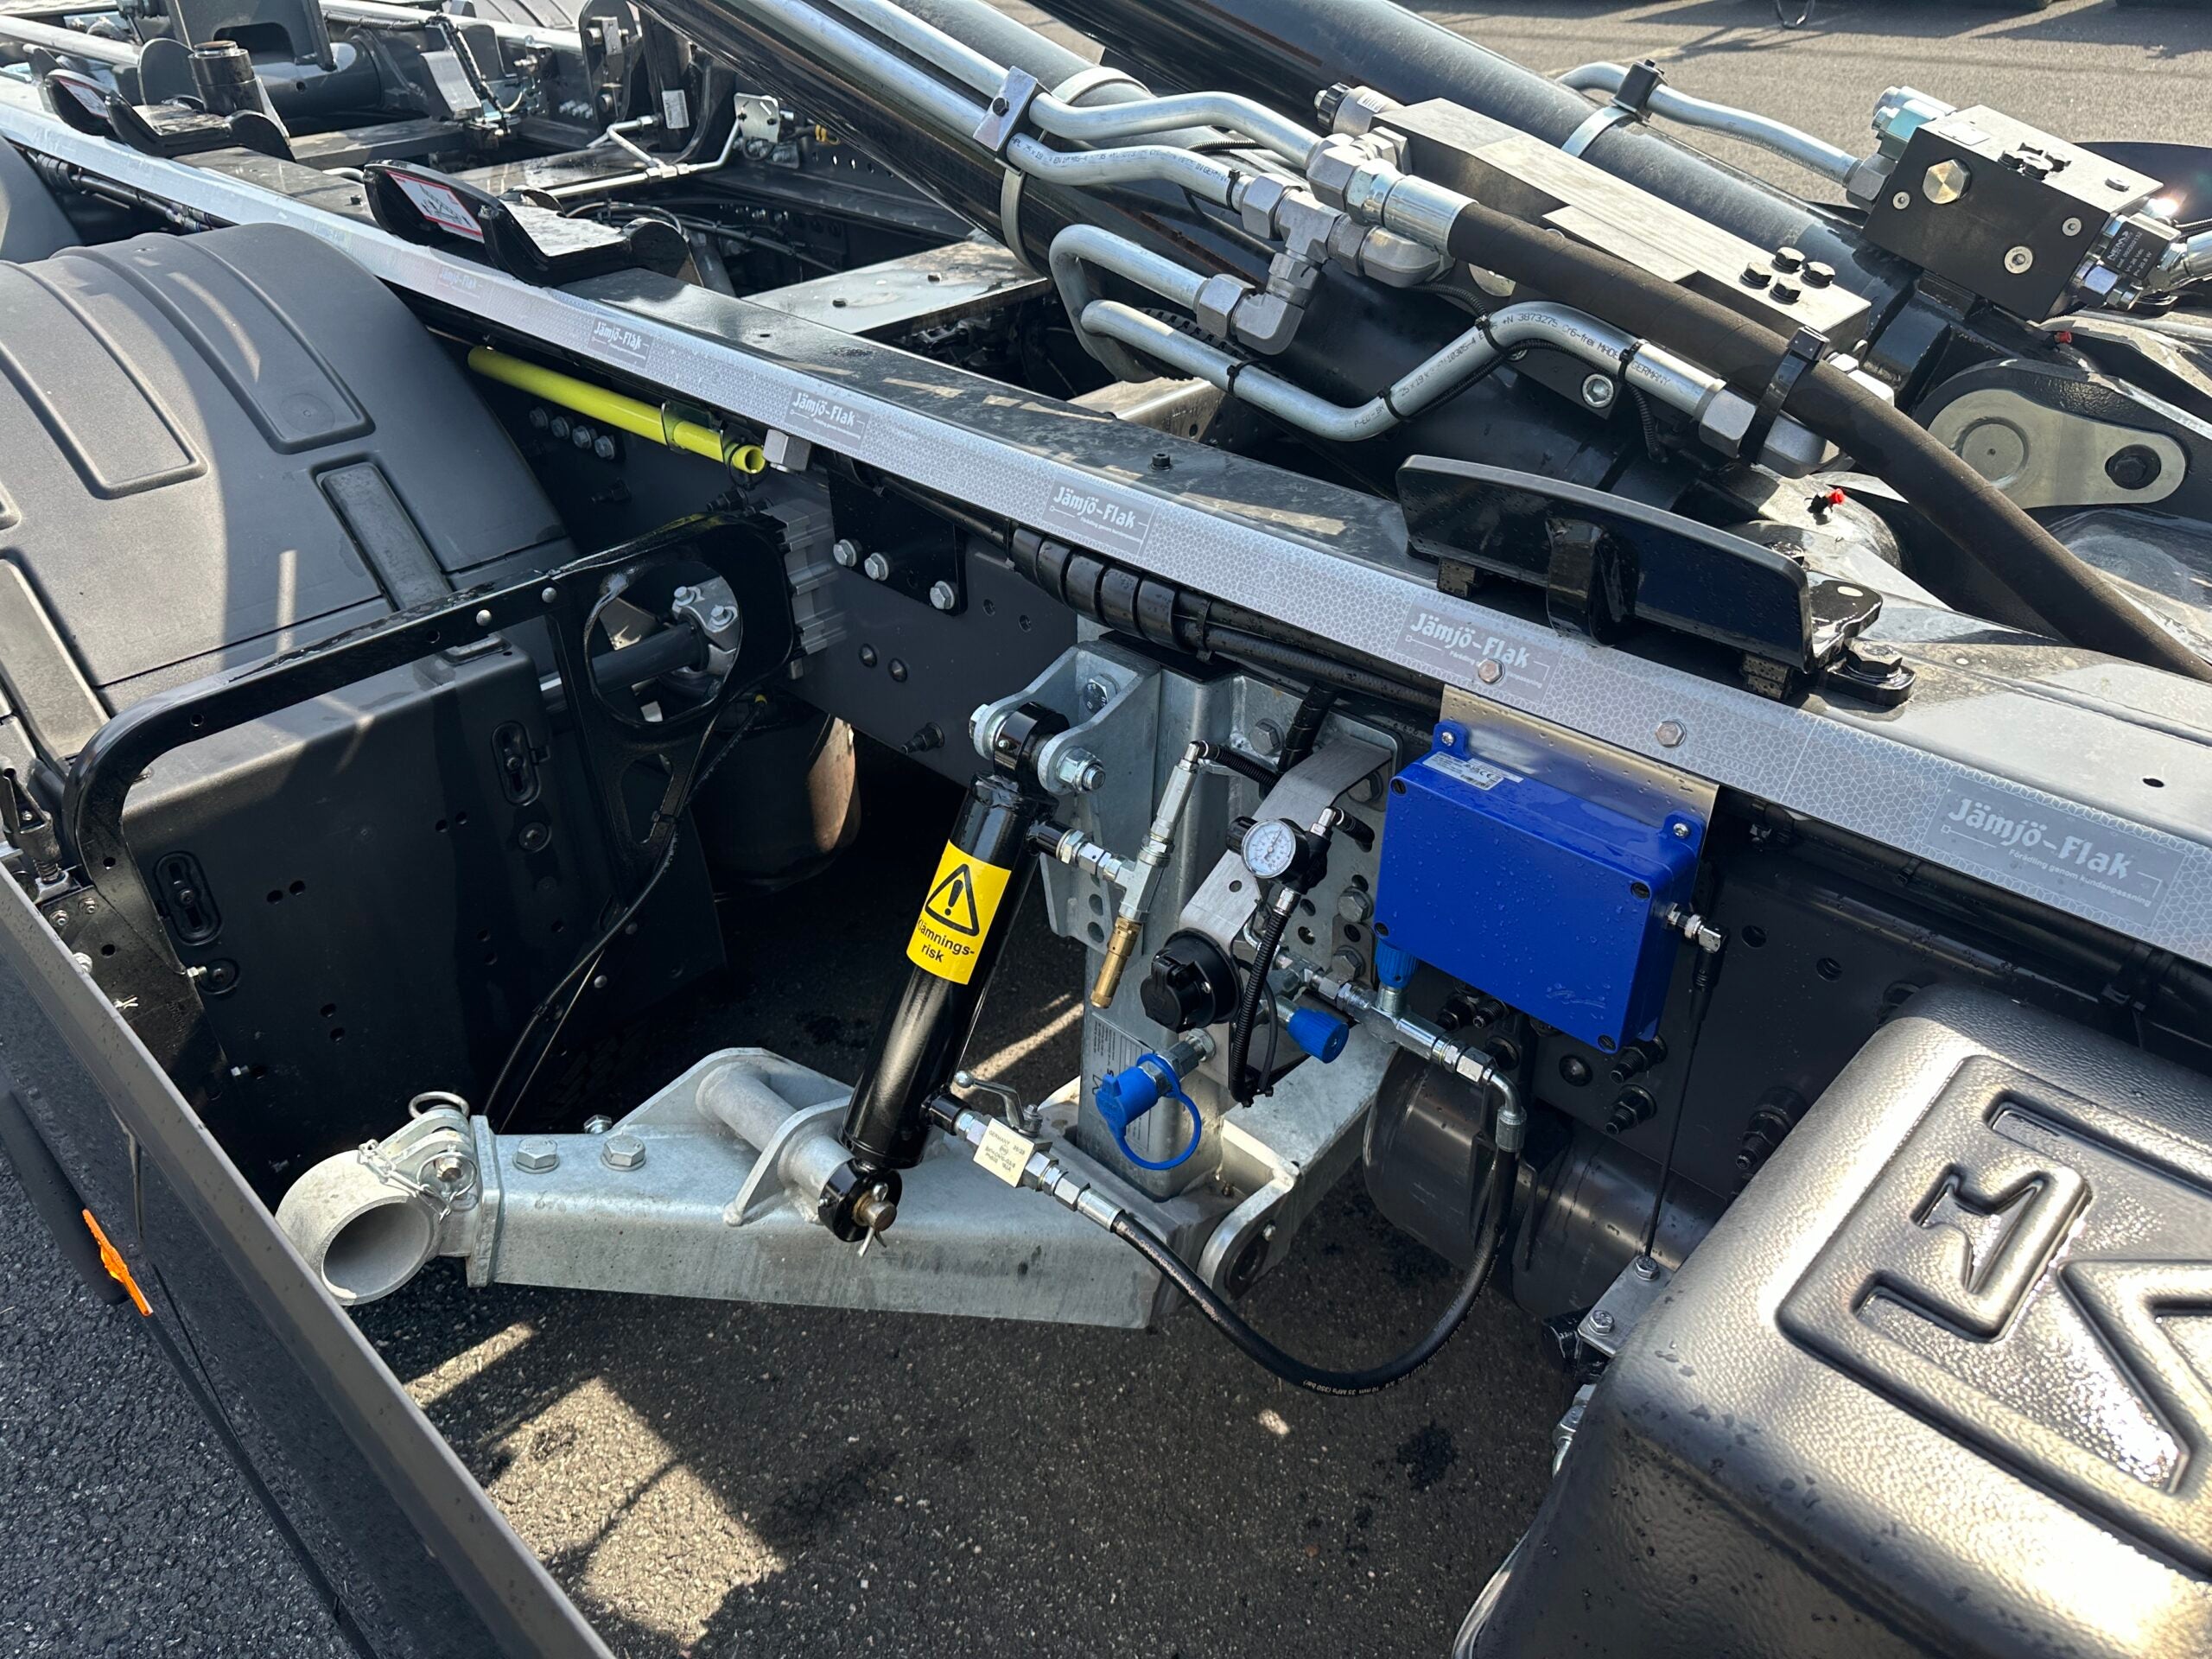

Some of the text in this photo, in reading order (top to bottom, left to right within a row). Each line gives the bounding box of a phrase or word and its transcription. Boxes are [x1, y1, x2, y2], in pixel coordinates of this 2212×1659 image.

[594, 321, 642, 350] Jämjö-Flak
[1631, 360, 1671, 387] GERMANY
[792, 392, 855, 427] Jämjö-Flak
[1053, 486, 1136, 529] Jämjö-Flak
[1410, 613, 1530, 669] Jämjö-Flak
[1948, 798, 2132, 880] Jämjö-Flak
[2008, 849, 2152, 907] Förädling genom kundanpassning
[921, 943, 944, 963] risk
